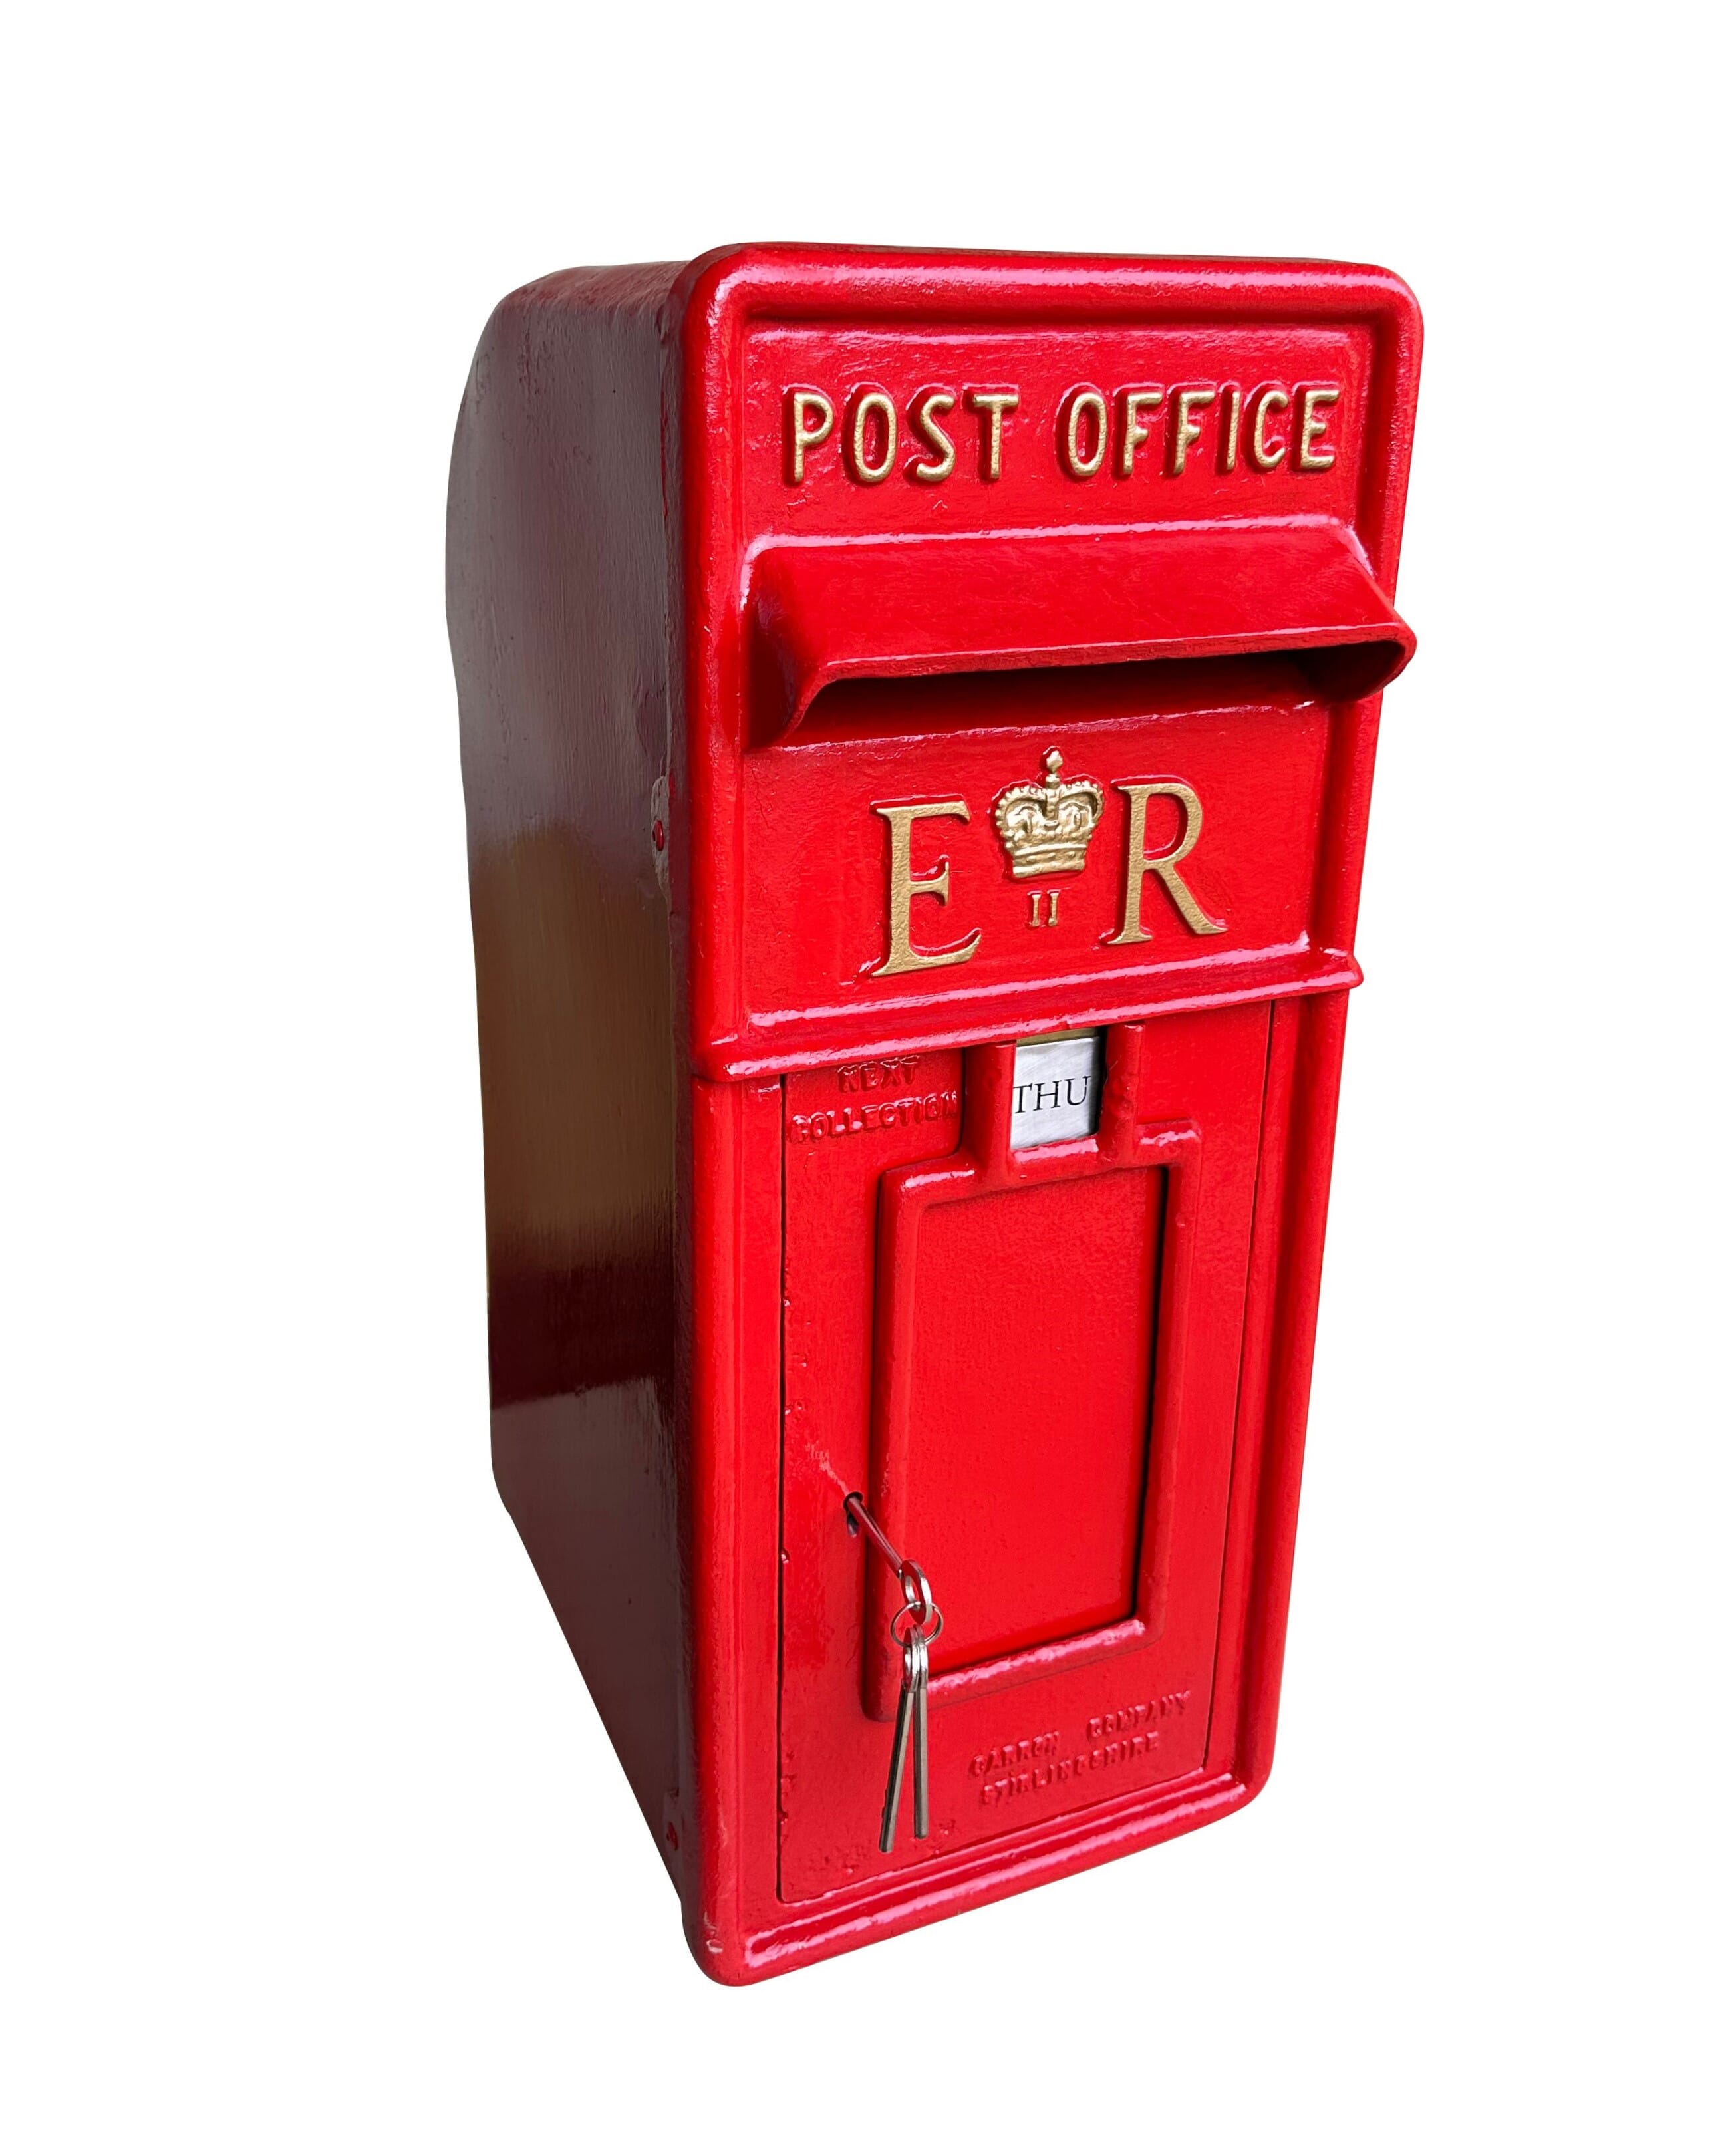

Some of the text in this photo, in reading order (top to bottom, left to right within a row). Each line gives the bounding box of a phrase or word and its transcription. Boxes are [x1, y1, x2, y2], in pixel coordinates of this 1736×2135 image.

[789, 388, 1340, 482] POST OFFICE
[870, 781, 1228, 978] E R
[1028, 891, 1060, 928] II
[837, 1054, 921, 1093] NEXT
[1012, 1075, 1092, 1115] THU
[789, 1089, 958, 1144] COLLECTION
[1086, 1690, 1191, 1741] COMPANY
